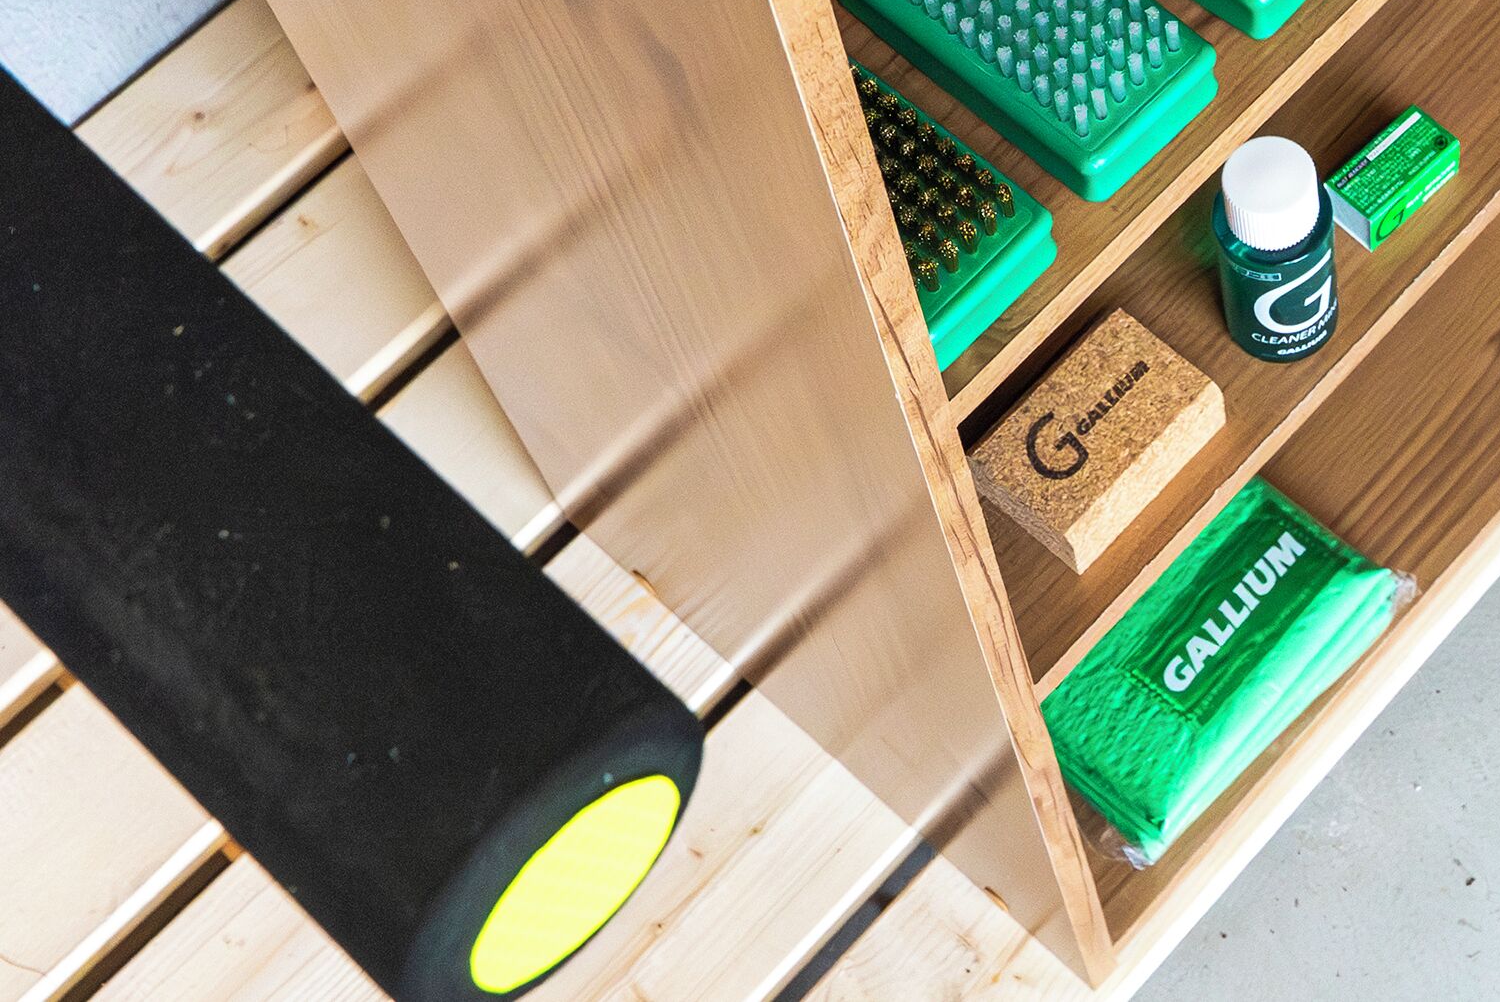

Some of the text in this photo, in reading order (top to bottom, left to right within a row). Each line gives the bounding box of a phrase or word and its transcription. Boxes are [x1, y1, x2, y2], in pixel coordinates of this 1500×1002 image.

[1253, 248, 1332, 334] G
[1251, 325, 1317, 345] CLEANER
[1277, 329, 1328, 355] GALLIUM
[1075, 359, 1151, 437] GALLIUM
[1026, 411, 1090, 480] G
[1162, 530, 1307, 694] GALLIUM
